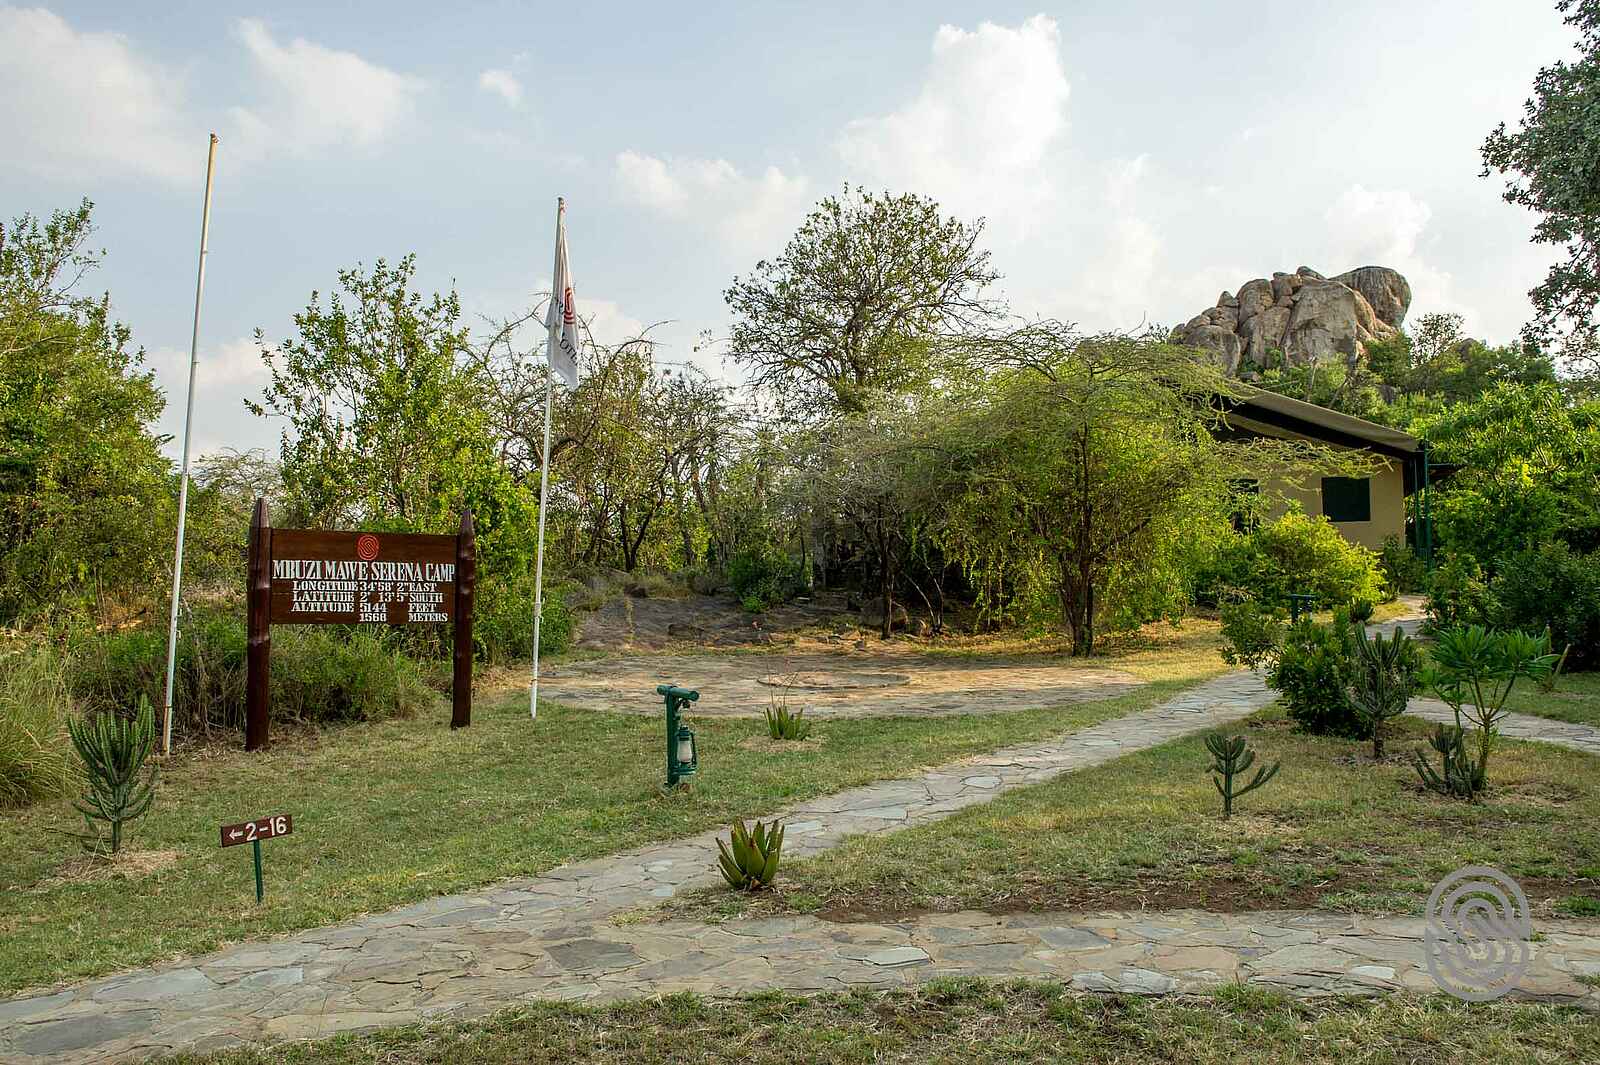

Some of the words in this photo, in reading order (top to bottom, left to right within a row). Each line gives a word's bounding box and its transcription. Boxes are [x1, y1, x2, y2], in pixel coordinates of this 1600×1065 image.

[272, 559, 322, 580] MBUZI
[324, 560, 369, 581] MAWE
[371, 561, 424, 582] SERENA
[425, 563, 456, 582] CAMP
[292, 580, 359, 592] LONGITUDE
[409, 582, 438, 593] EAST
[292, 590, 355, 602] LATITUDE
[409, 592, 444, 603] SOUTH
[291, 601, 355, 612] ALTITUDE
[360, 602, 388, 613] 5144
[408, 602, 437, 613] FEET
[408, 612, 449, 622] METERS
[245, 816, 287, 841] 2-16
